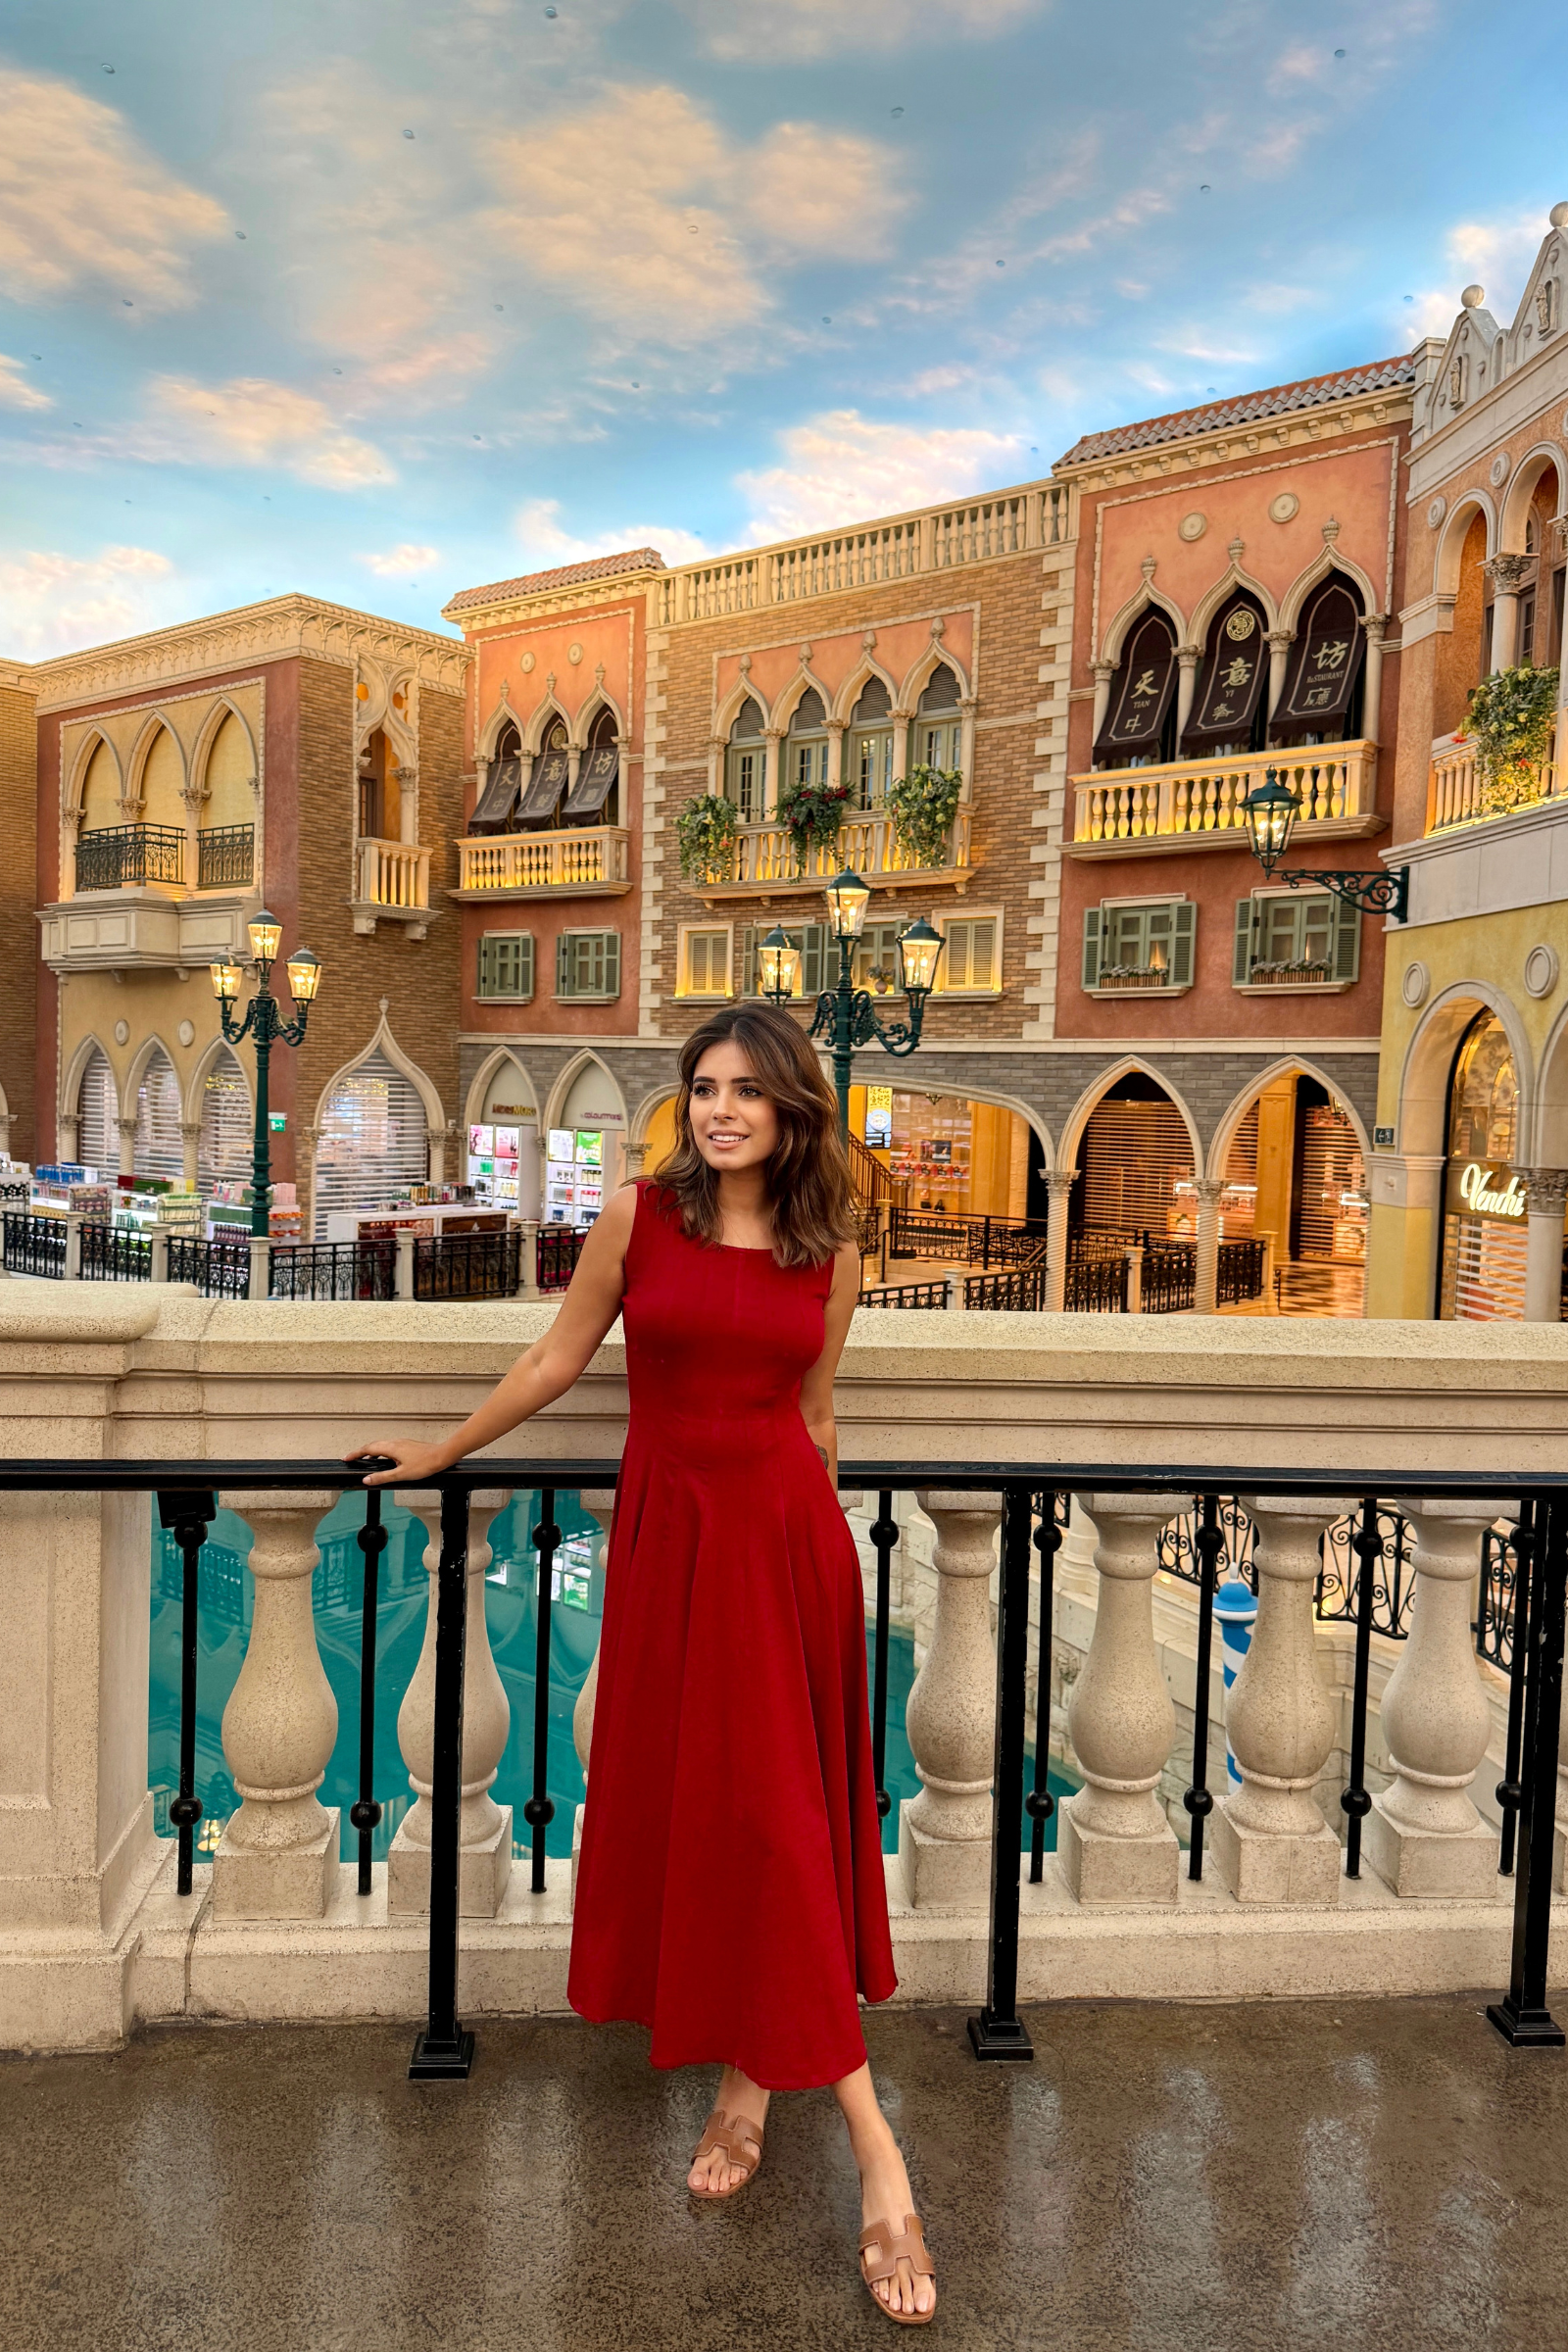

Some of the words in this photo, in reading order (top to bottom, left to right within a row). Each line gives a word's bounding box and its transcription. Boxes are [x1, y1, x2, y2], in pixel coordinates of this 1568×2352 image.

[1311, 641, 1349, 670] 坊
[1130, 669, 1159, 699] 天
[1219, 657, 1253, 688] 意
[1133, 699, 1151, 710] TIAN
[1125, 714, 1142, 733] 中
[544, 759, 563, 782] 意
[595, 752, 613, 775] 坊
[1460, 1163, 1527, 1217] Venchi
